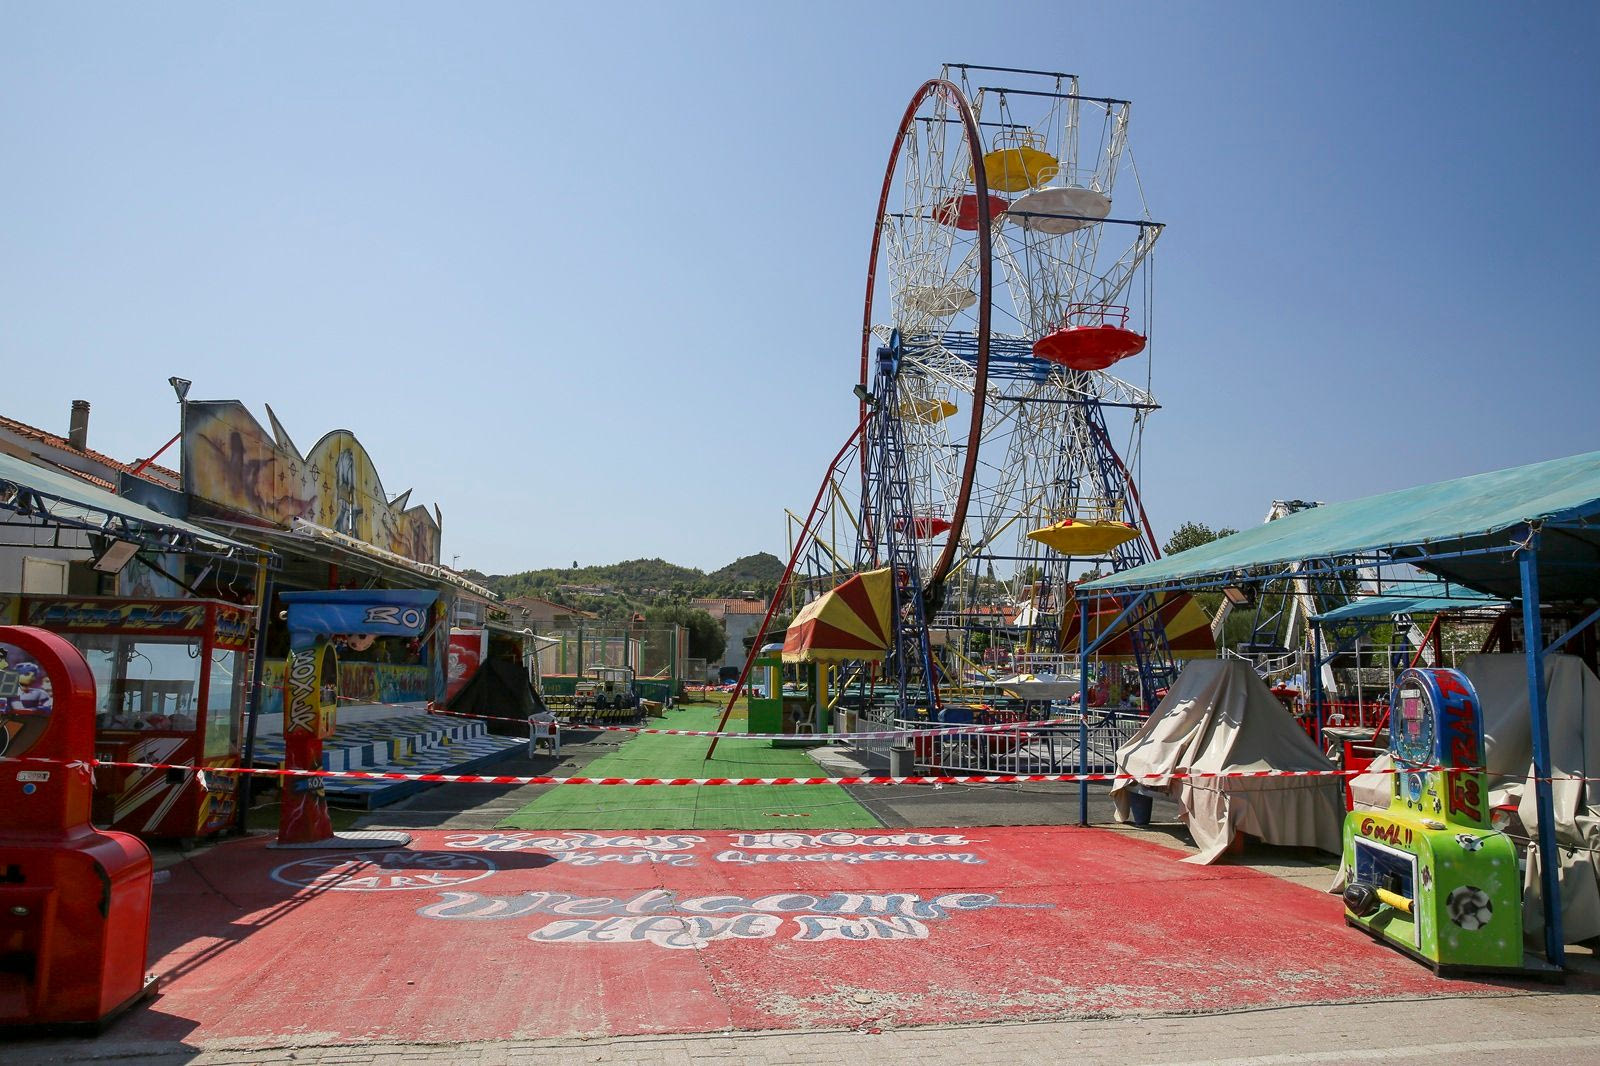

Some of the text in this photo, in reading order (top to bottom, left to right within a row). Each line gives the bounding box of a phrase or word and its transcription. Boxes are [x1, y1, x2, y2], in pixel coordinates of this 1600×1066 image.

[363, 605, 427, 631] BO
[287, 649, 317, 733] BOXER
[420, 889, 1005, 921] Welcome
[528, 914, 782, 949] HAVE
